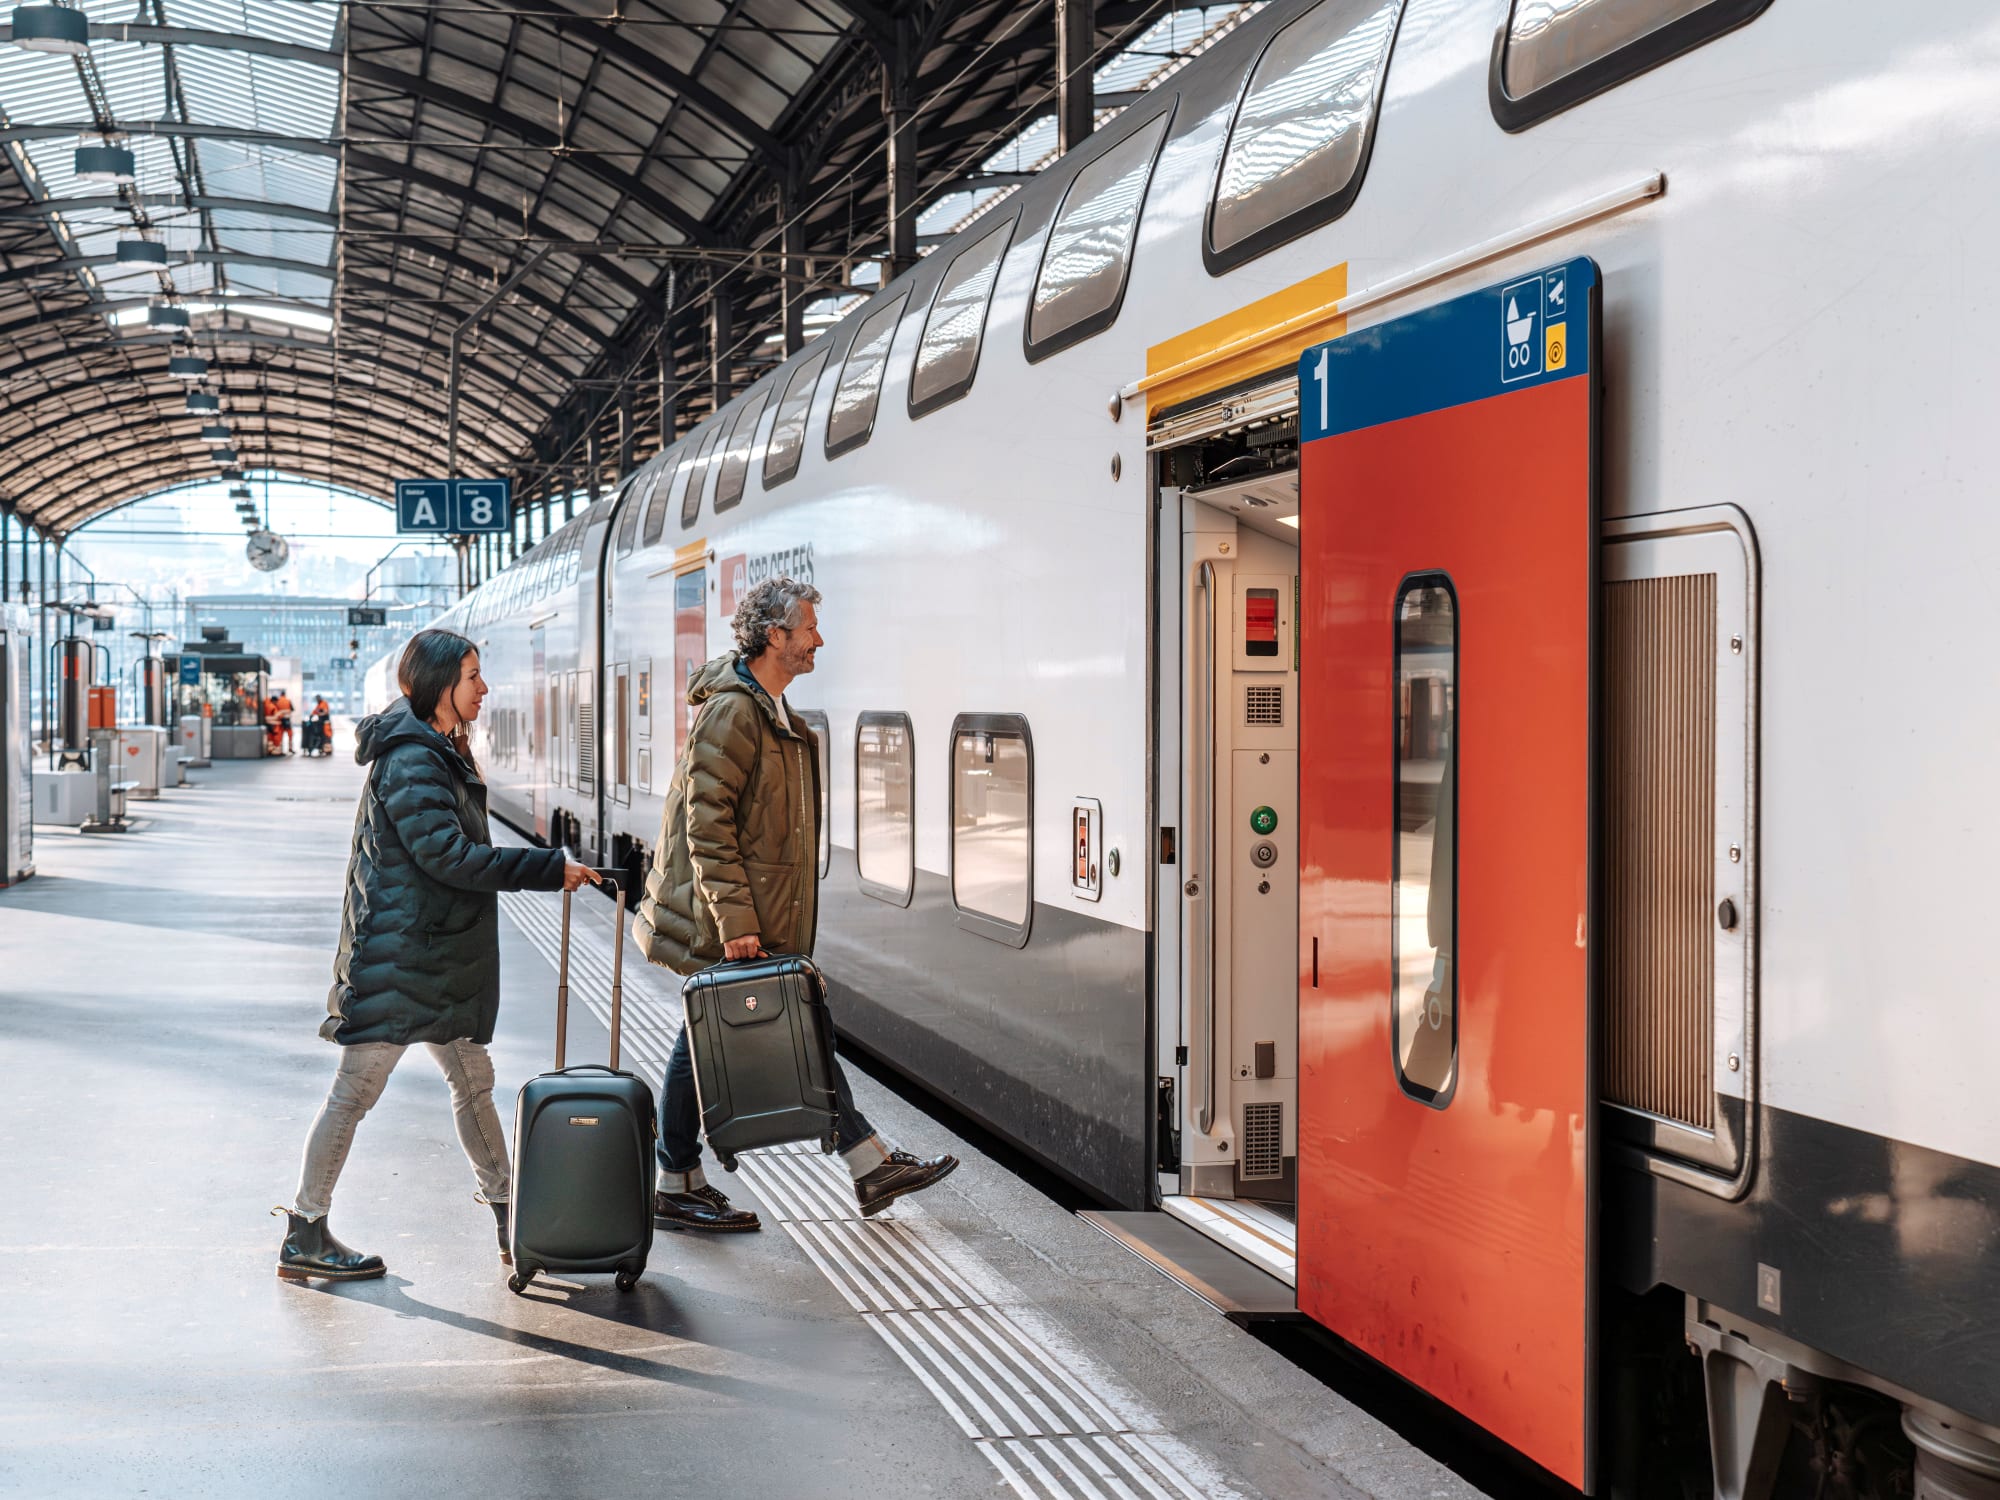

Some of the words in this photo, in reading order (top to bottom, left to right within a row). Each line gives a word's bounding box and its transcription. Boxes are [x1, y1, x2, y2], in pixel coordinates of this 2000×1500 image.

[1313, 347, 1329, 431] 1
[412, 497, 437, 525] A
[470, 496, 493, 525] 8
